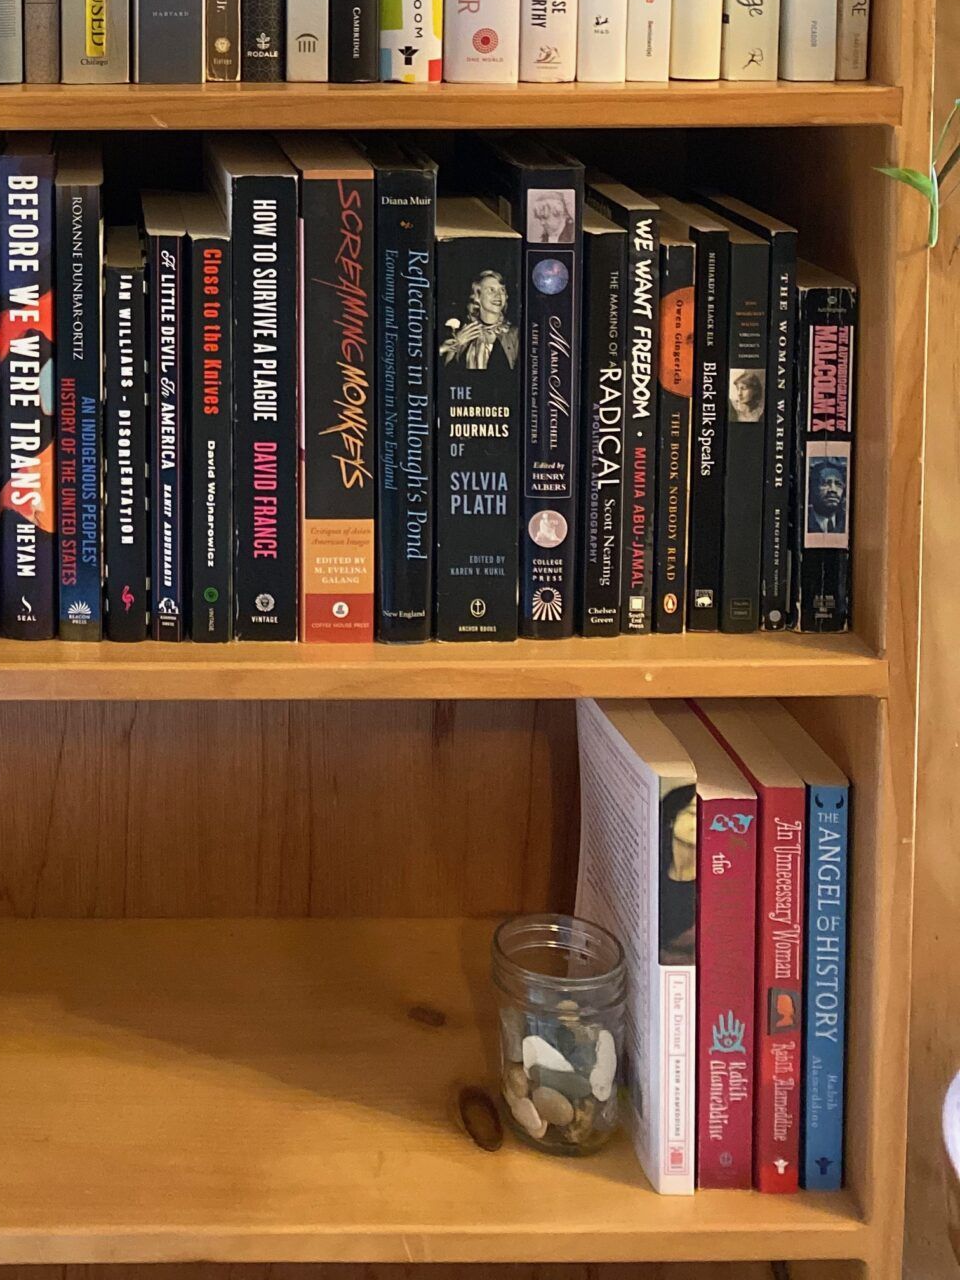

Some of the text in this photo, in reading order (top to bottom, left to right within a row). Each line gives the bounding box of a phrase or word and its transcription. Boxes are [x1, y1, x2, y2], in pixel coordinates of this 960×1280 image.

[247, 50, 278, 58] RODALE
[381, 196, 431, 205] Diana Muir
[203, 248, 221, 416] Close to the Knives
[8, 176, 41, 577] BEFORE WE WERE TRANS HEYAM
[253, 200, 277, 559] HOW TO SURVIVE A PLAGUE DAVID FRANCE
[450, 387, 471, 400] THE
[450, 406, 509, 418] UNABRIDGED
[698, 361, 718, 476] Black Elk Speaks
[449, 423, 509, 438] JOURNALS
[450, 443, 464, 457] OF
[450, 471, 507, 493] SYLVIA
[450, 494, 506, 515] PLATH
[818, 813, 839, 822] THE
[816, 827, 841, 1043] ANGEL OF HISTORY
